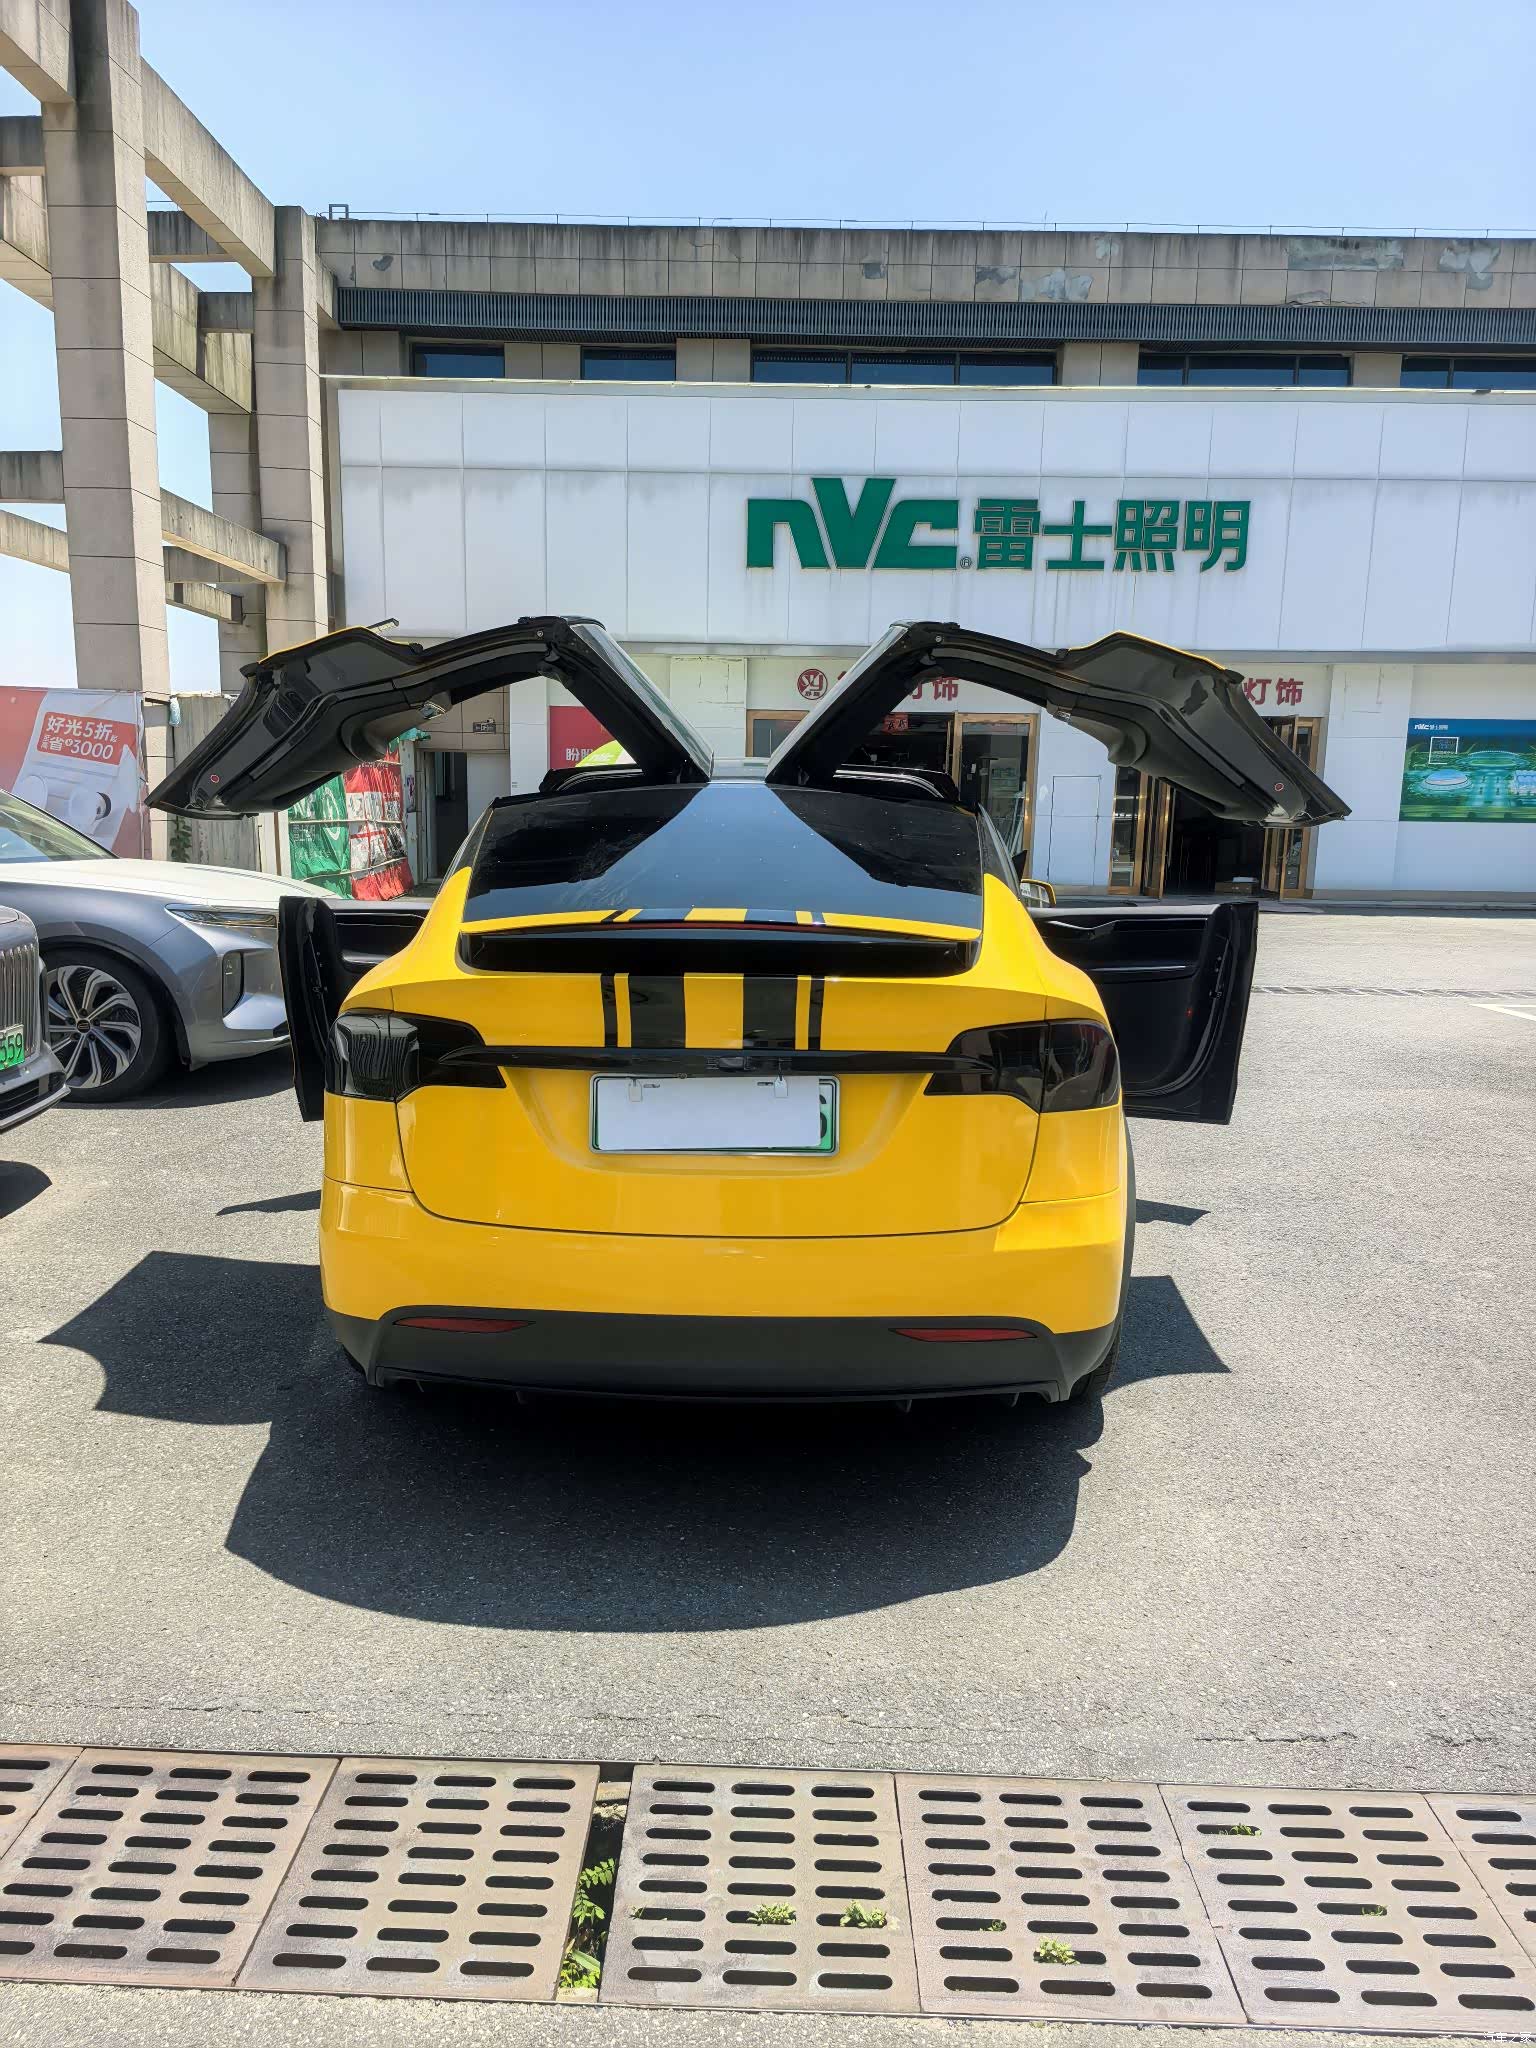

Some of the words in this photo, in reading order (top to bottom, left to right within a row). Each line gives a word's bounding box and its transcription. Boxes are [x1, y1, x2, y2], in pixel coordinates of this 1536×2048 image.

[974, 498, 1251, 573] 雷士照明
[912, 677, 959, 701] 饰
[1243, 677, 1304, 706] 灯饰
